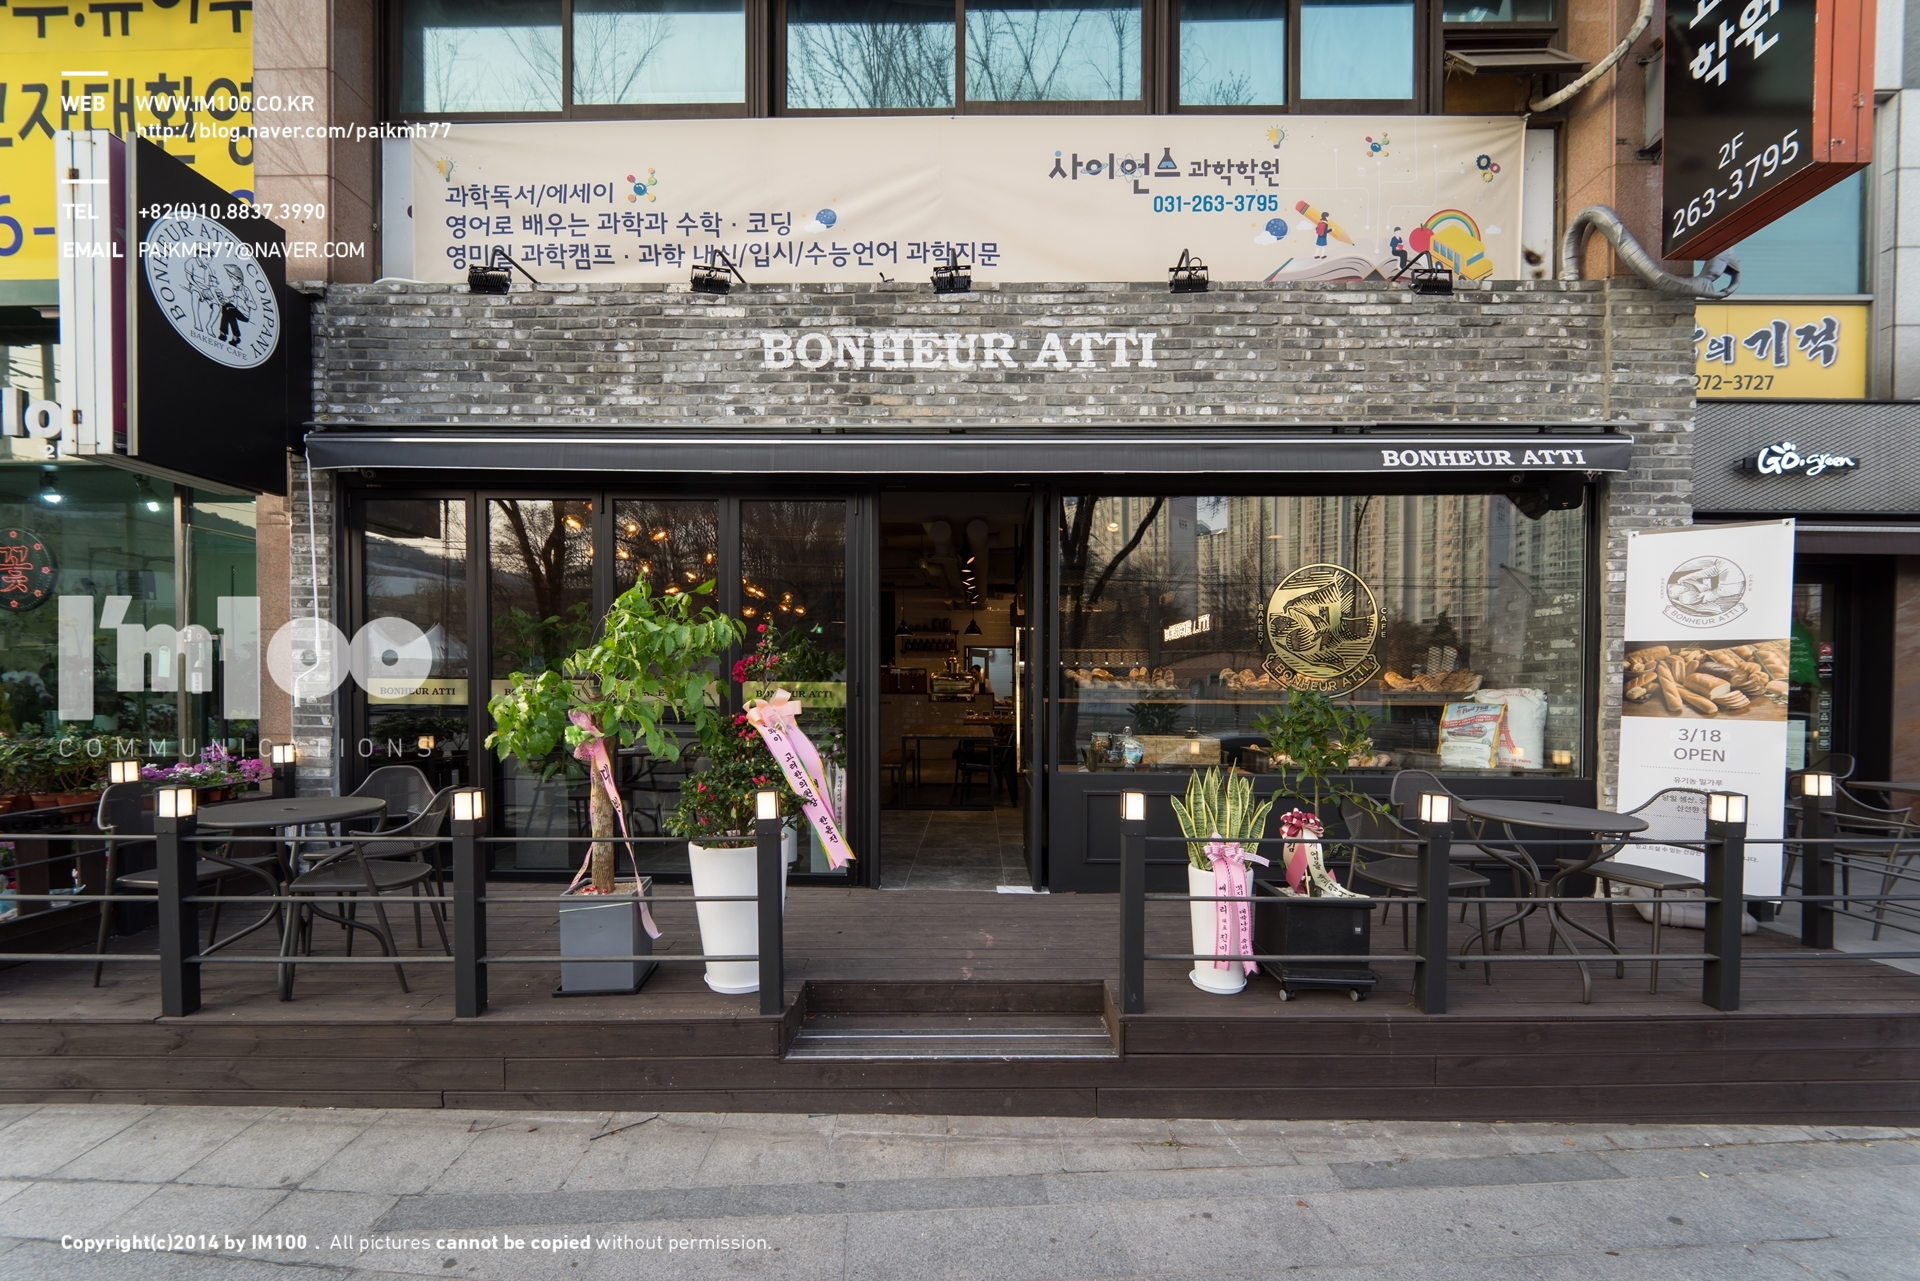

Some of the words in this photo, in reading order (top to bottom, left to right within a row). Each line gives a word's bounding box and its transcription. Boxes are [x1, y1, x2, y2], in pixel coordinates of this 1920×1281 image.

[1718, 131, 1745, 170] 2F
[1048, 147, 1181, 195] 사이언스
[1188, 158, 1280, 187] 과학학원
[1672, 128, 1800, 238] 263-3795
[445, 182, 614, 210] 과학독서/에세이
[1153, 194, 1279, 213] 031-263-3795
[446, 214, 514, 239] 영어로
[522, 213, 590, 237] 배우는
[597, 211, 668, 237] 과학과
[676, 211, 723, 238] 수학
[746, 211, 792, 236] 코딩
[521, 243, 615, 270] 과학캠프
[638, 244, 685, 268] 과학
[246, 263, 275, 359] COMPANY
[190, 330, 225, 350] BAKERY
[227, 346, 248, 361] CAFE
[760, 332, 1019, 370] BONHEUR
[1027, 332, 1158, 369] ATTI
[1694, 326, 1734, 363] 의
[1743, 315, 1840, 367] 기적
[1381, 449, 1515, 467] BONHEUR
[1522, 449, 1586, 465] ATTI
[1380, 607, 1388, 639] CAFE
[1670, 610, 1716, 625] BONHEUR
[1718, 608, 1739, 621] ATTI
[1274, 662, 1338, 692] BONHEUR
[1342, 663, 1369, 688] ATTI
[380, 687, 429, 696] BONHEUR
[432, 687, 456, 696] ATTI
[809, 690, 833, 698] ATTI
[1678, 728, 1722, 743] 3/18
[1673, 748, 1726, 763] OPEN
[1673, 777, 1697, 786] 유기농
[1699, 778, 1723, 786] 밀가루
